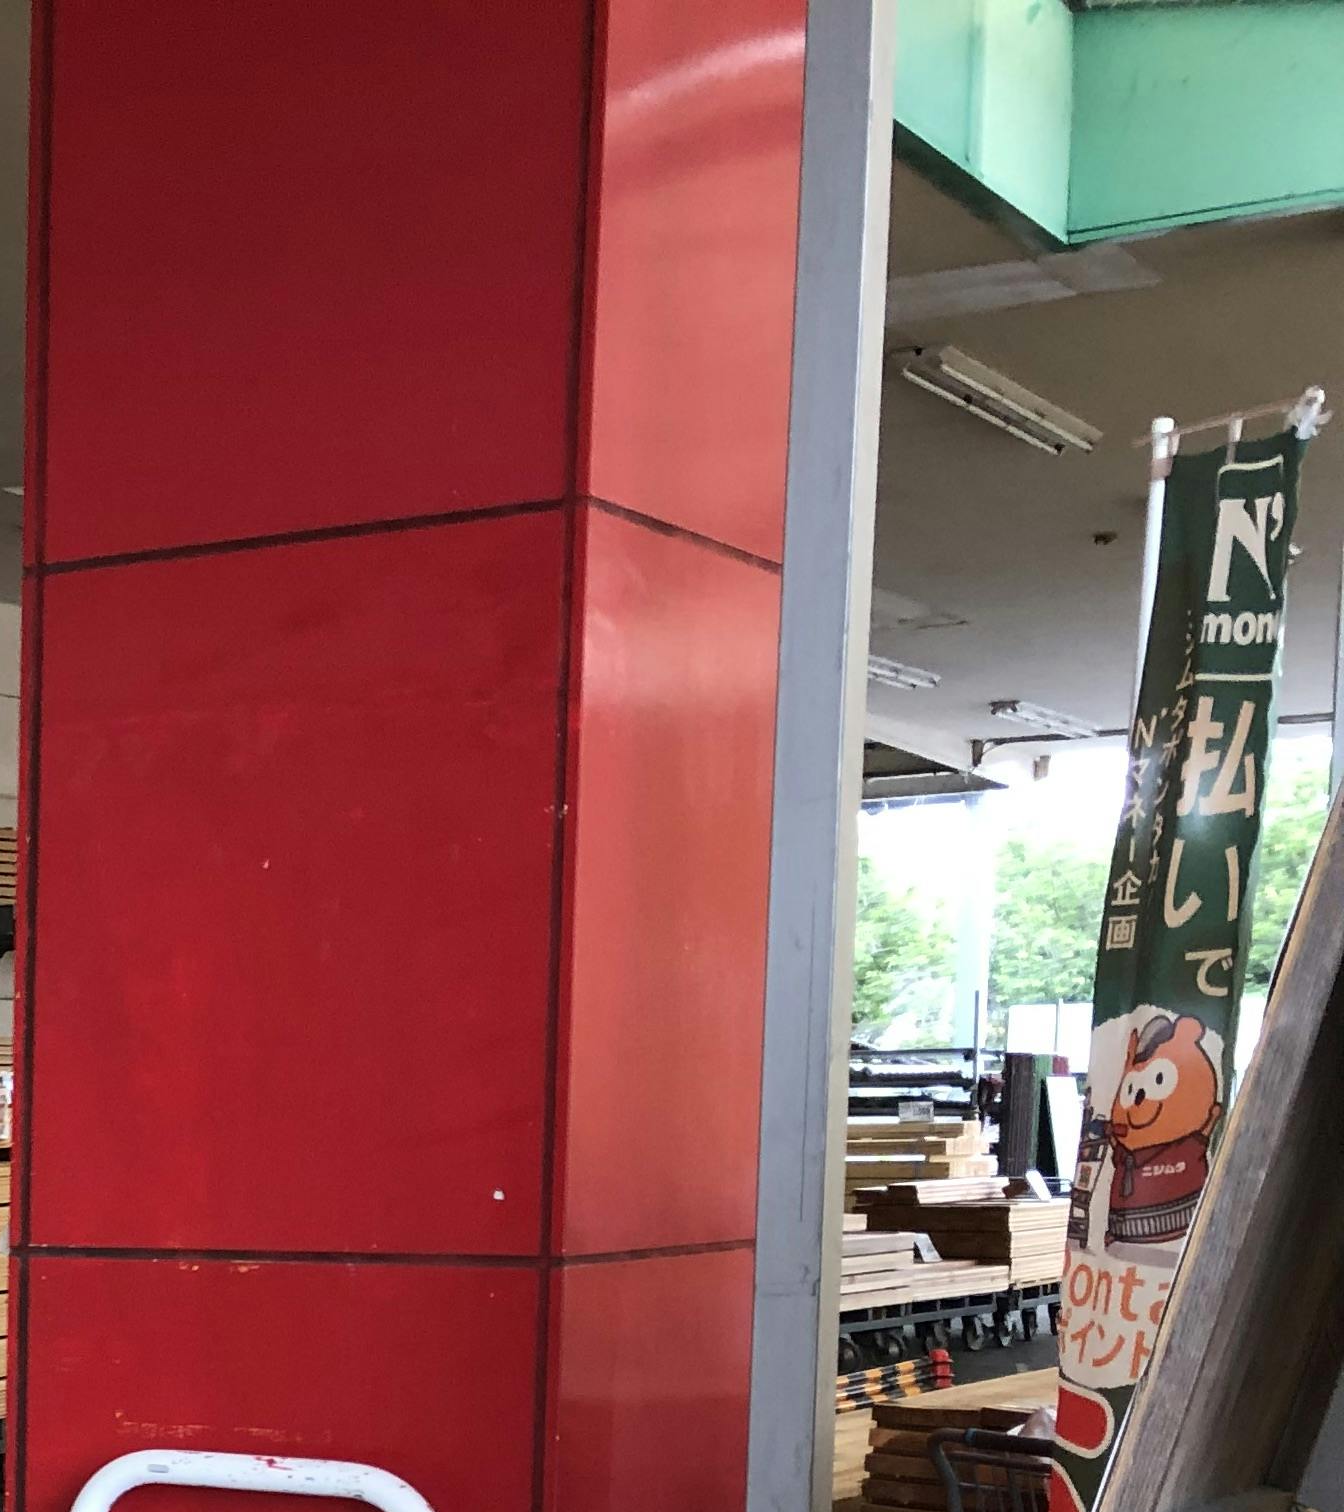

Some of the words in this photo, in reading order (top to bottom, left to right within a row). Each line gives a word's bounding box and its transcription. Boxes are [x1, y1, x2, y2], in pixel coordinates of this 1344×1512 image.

[1200, 609, 1280, 646] mon
[1164, 696, 1256, 997] 払いで
